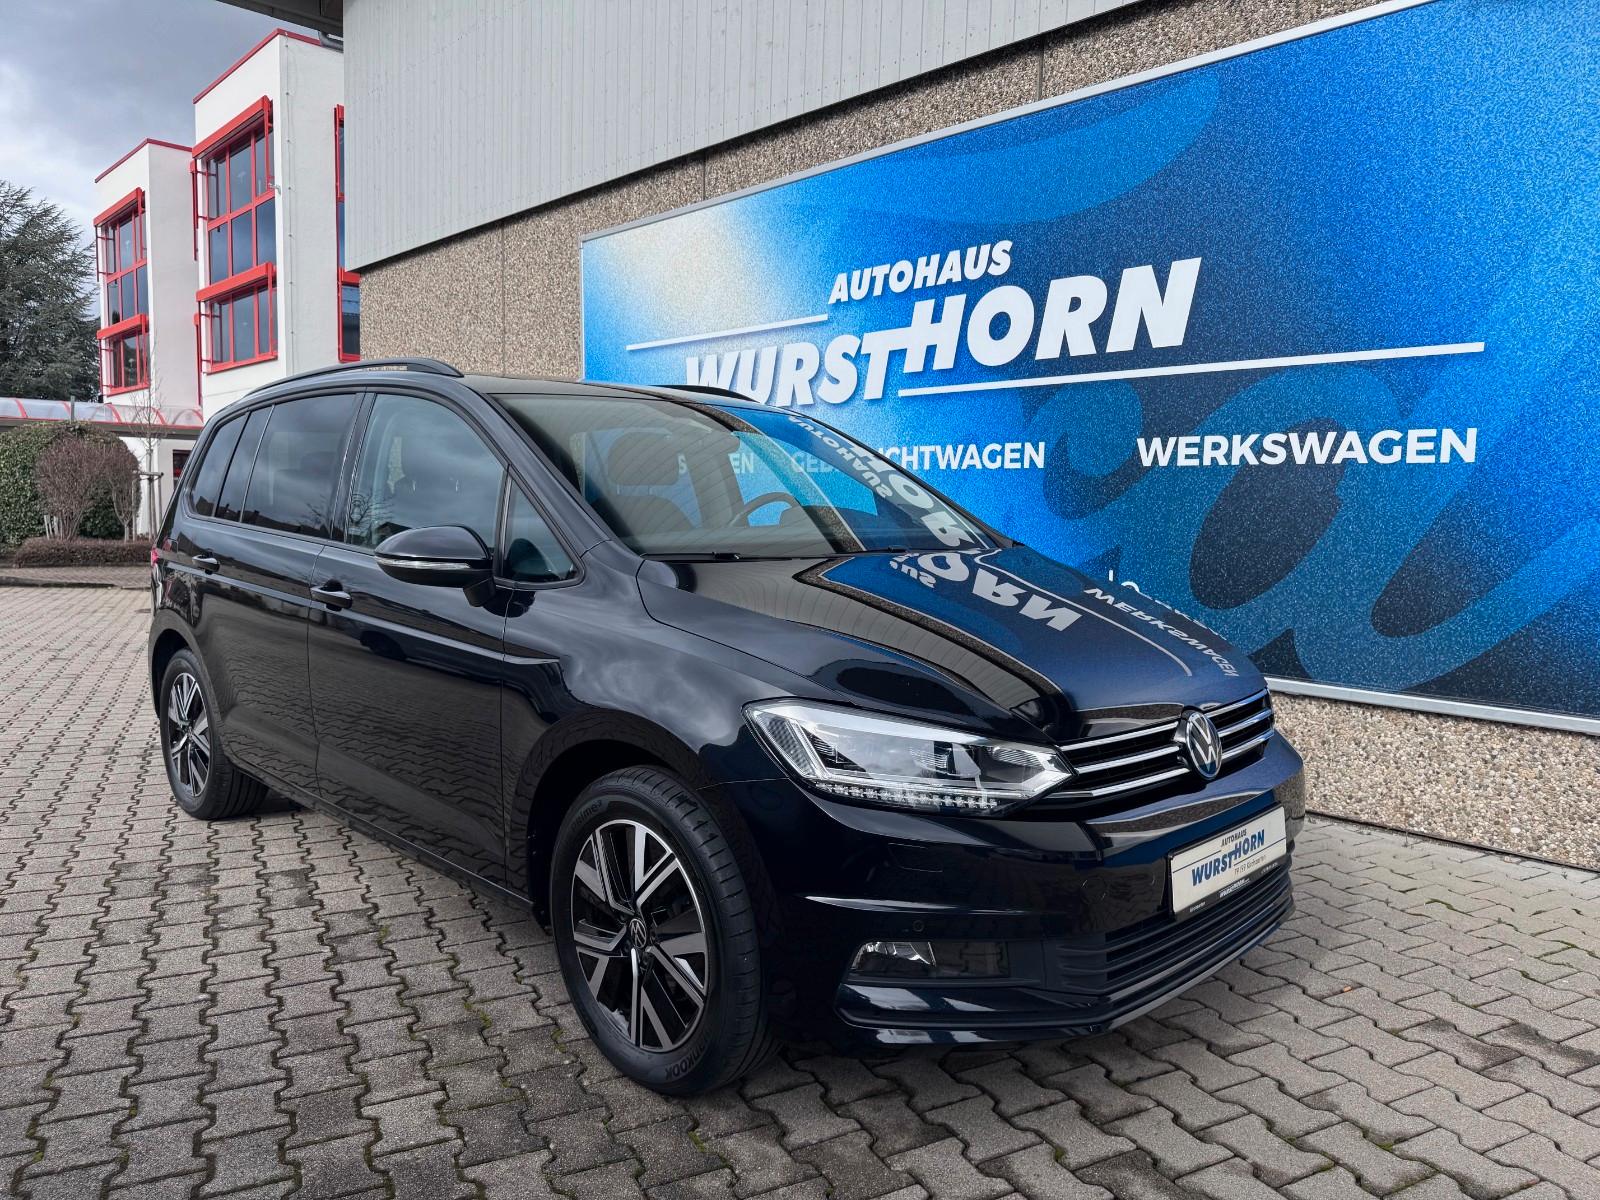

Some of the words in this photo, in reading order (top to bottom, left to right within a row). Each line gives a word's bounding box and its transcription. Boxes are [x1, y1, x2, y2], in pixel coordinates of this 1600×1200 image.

[828, 240, 1013, 305] AUTOHAUS
[686, 257, 1201, 407] WURSTHORN
[1137, 428, 1477, 466] WERKSWAGEN
[1192, 829, 1265, 887] WURSTHORN
[1221, 829, 1247, 847] AUTOHAUS
